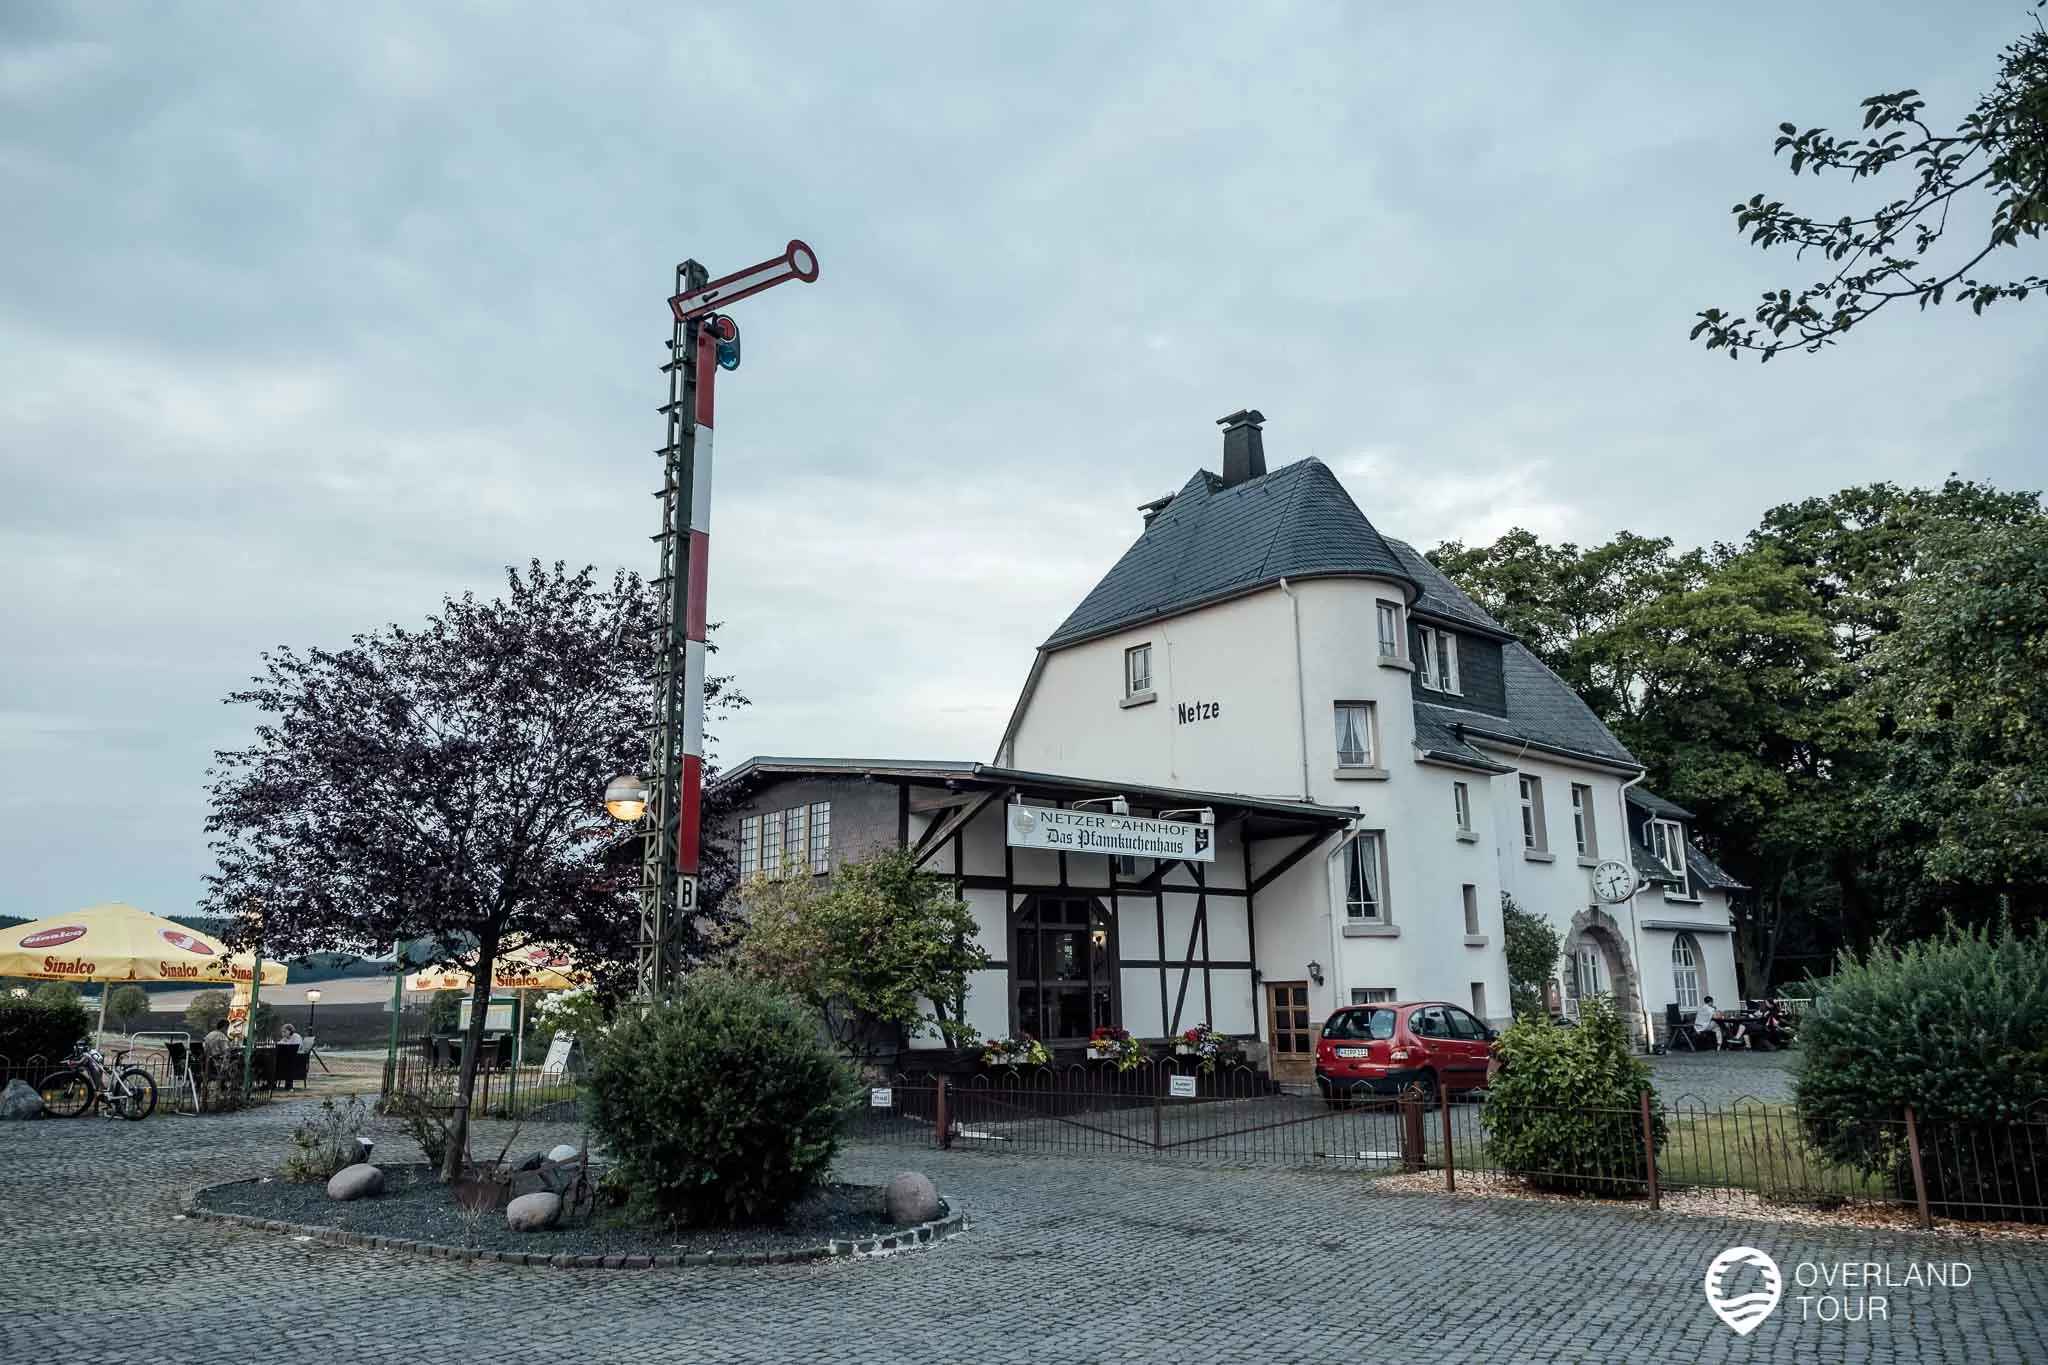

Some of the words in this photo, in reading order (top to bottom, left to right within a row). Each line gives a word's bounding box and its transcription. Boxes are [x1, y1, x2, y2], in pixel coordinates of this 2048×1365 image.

[1178, 700, 1220, 725] Netze
[1040, 811, 1105, 828] NETZER
[1046, 827, 1073, 844] Das
[1077, 828, 1184, 854] Pfannkuchenhaus
[682, 879, 692, 907] B
[43, 955, 96, 975] Sinalco
[160, 961, 198, 978] Sinalco
[496, 974, 539, 987] Sinalco
